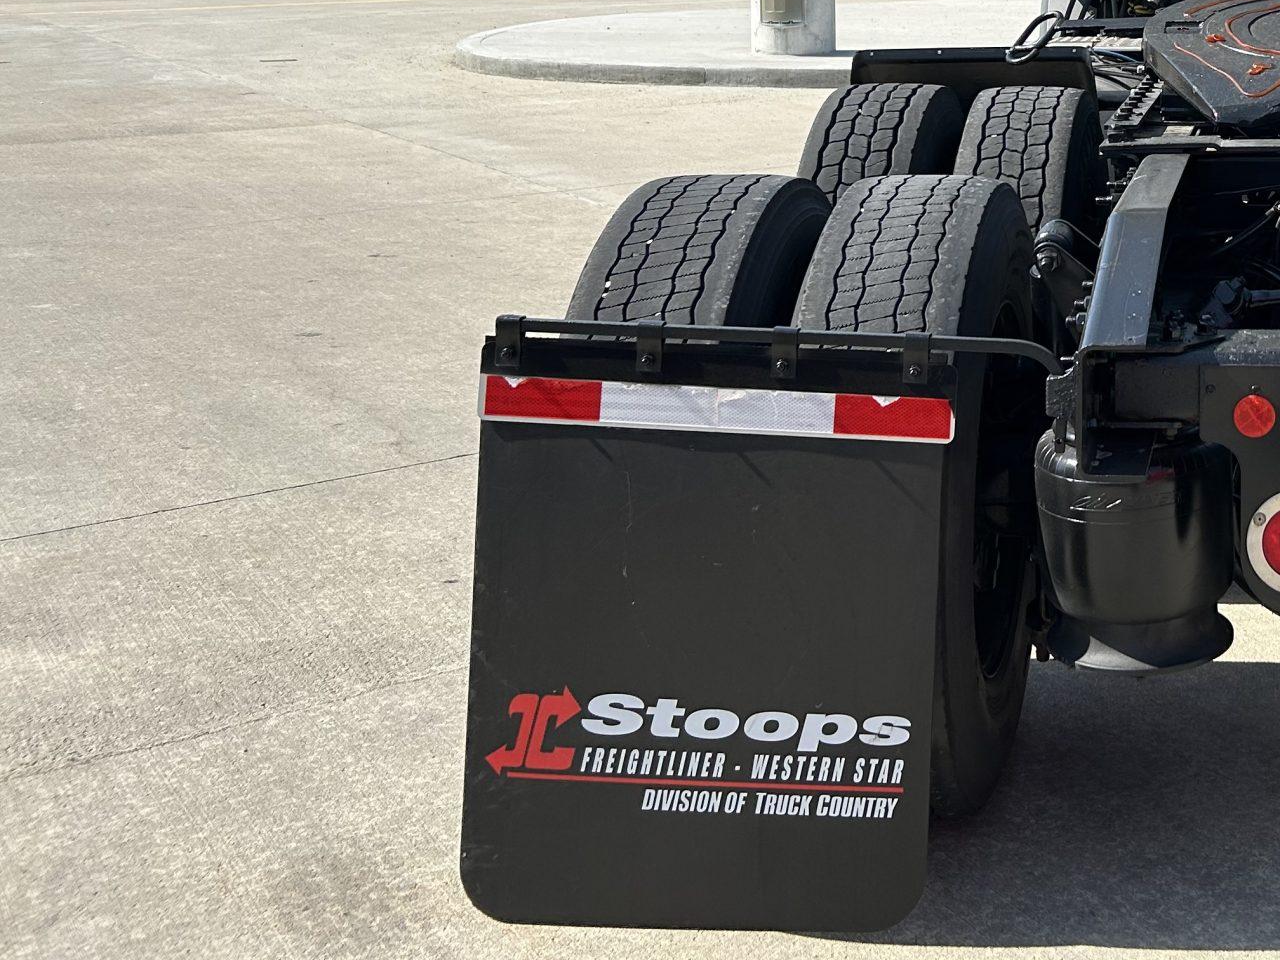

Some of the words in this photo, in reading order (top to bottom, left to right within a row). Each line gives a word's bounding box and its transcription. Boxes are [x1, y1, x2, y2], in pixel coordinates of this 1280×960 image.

[581, 693, 912, 752] Stoops
[580, 746, 726, 779] FREIGHTLINER
[750, 754, 846, 783] WESTERN
[853, 757, 905, 785] STAR
[641, 788, 723, 814] DIVISION
[724, 791, 748, 815] OF
[754, 792, 813, 817] TRUCK
[816, 794, 899, 819] COUNTRY
